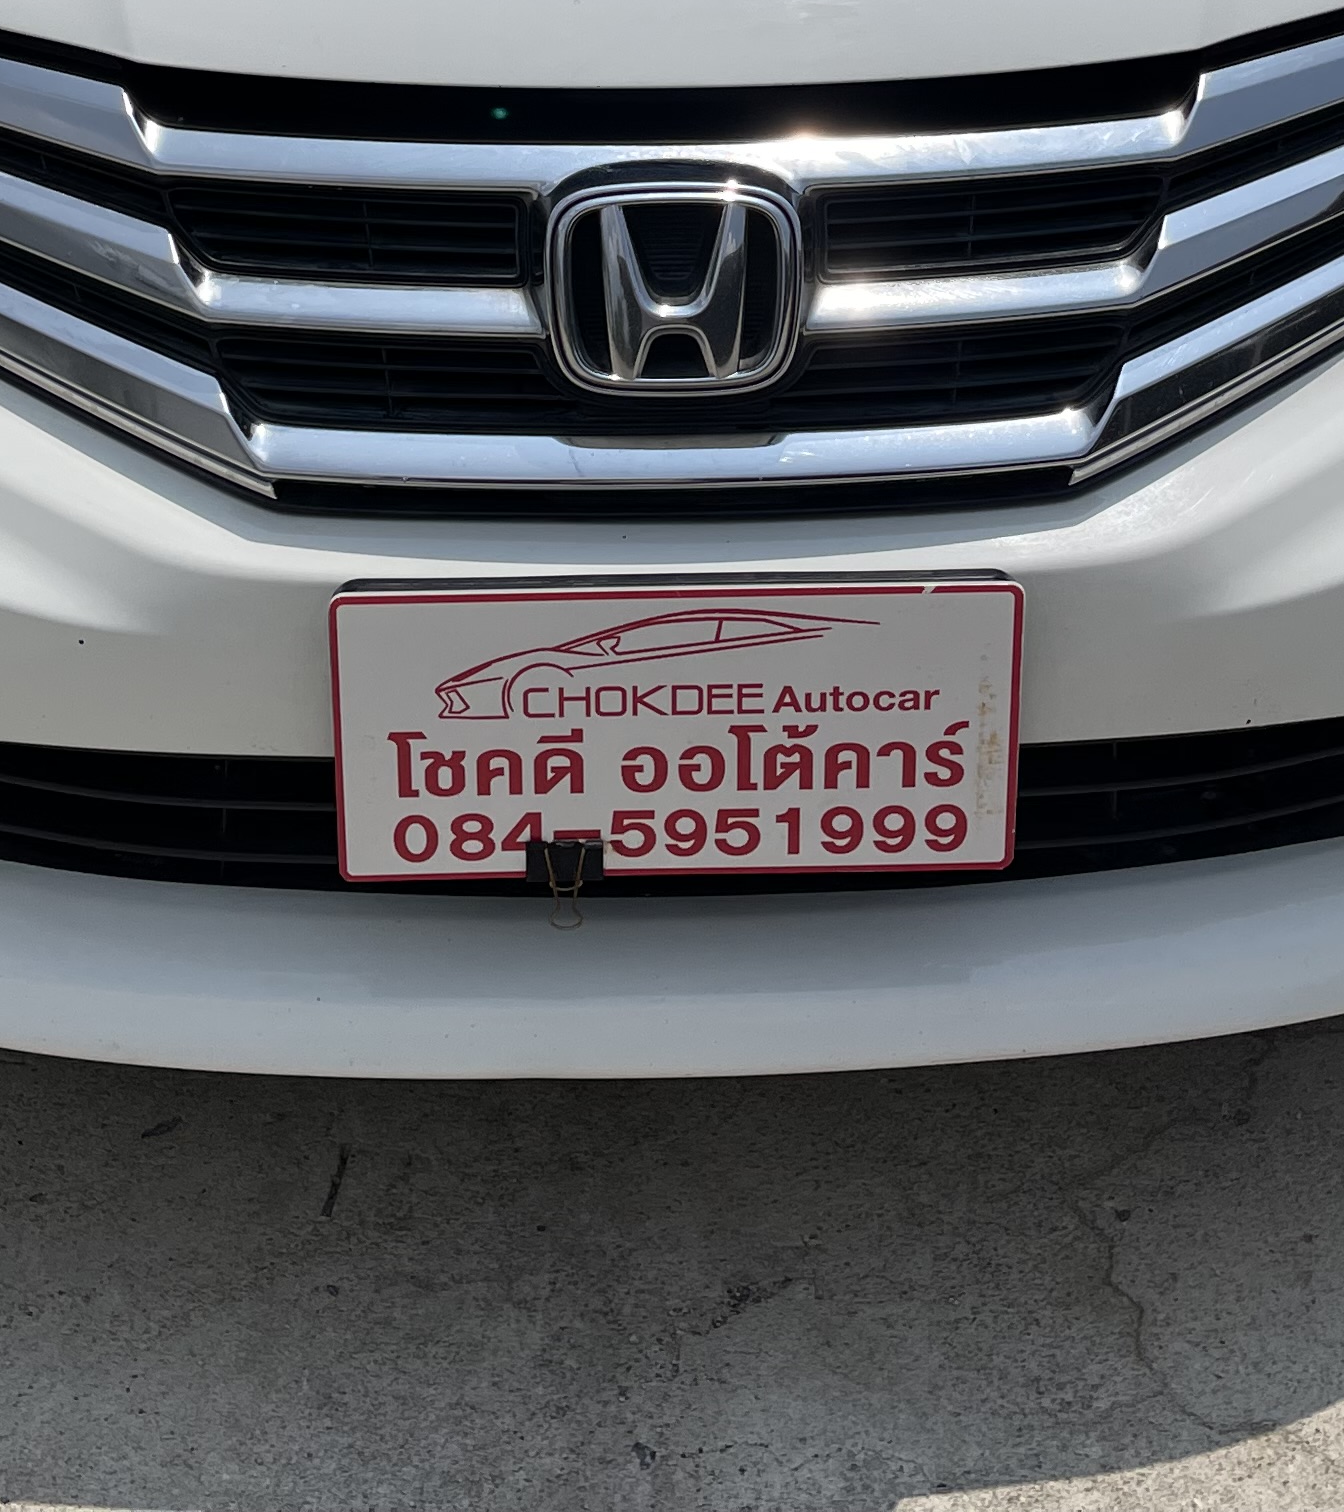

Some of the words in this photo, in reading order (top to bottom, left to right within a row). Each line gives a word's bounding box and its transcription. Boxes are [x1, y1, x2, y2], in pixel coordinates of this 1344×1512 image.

[522, 683, 765, 719] CHOKDEE
[772, 685, 941, 713] Autocar
[387, 727, 585, 798] โชคดี
[620, 720, 970, 793] ออโต้คาร์
[393, 803, 968, 863] 084-5951999
